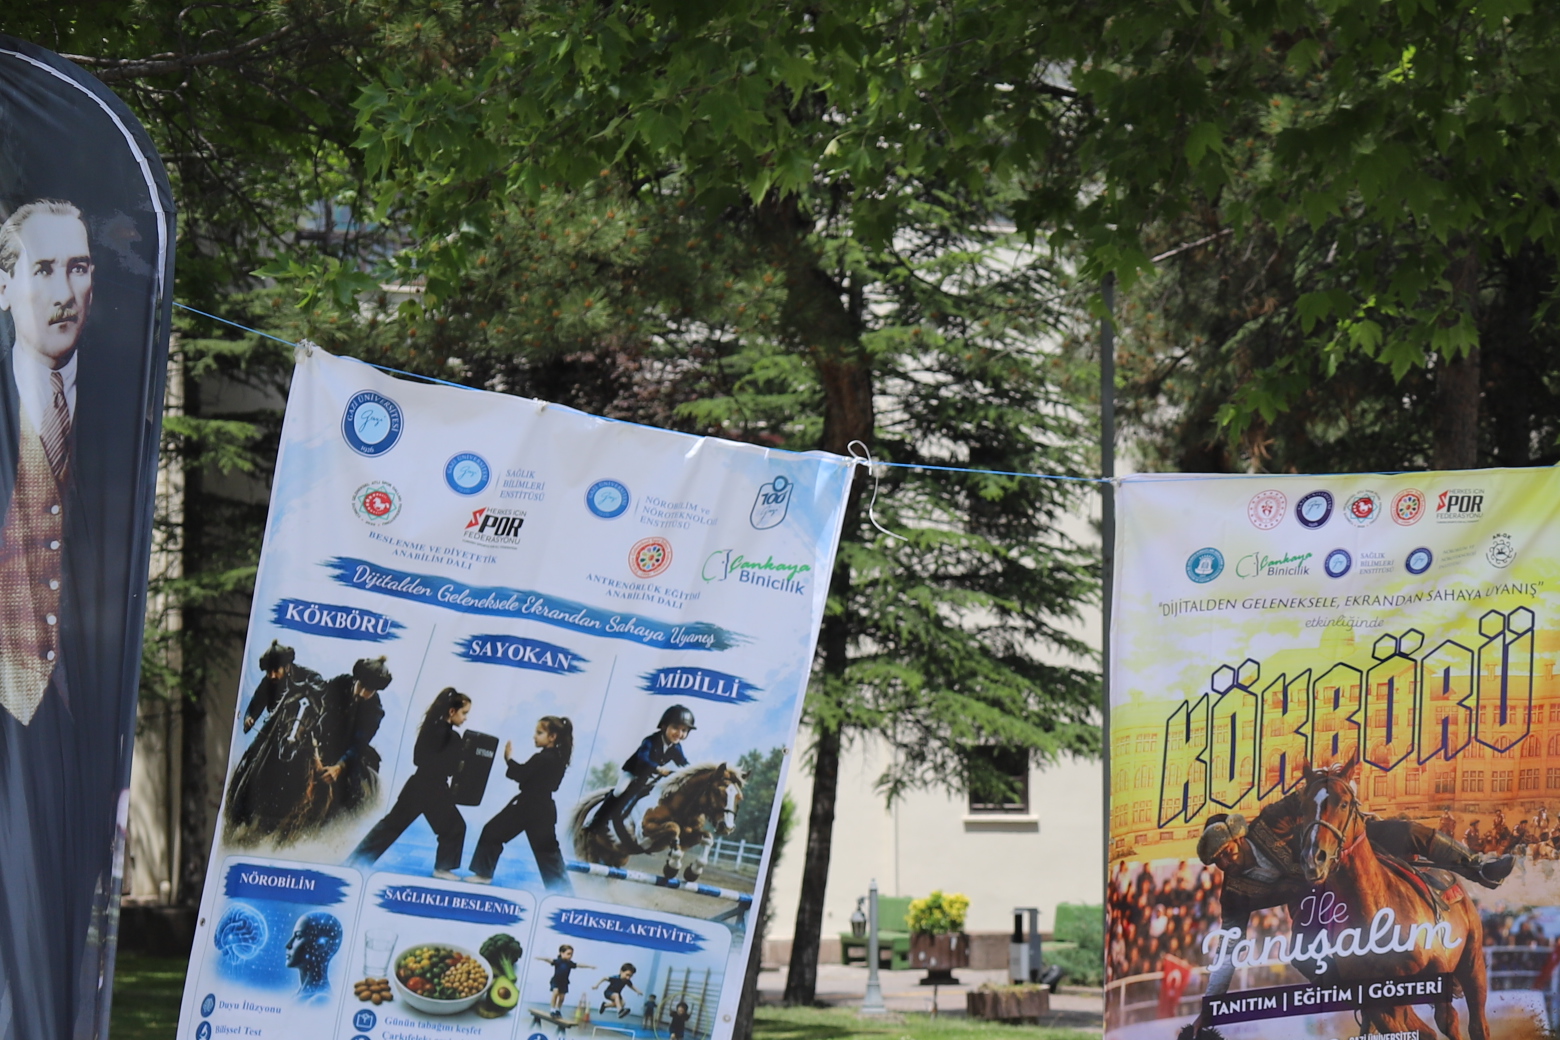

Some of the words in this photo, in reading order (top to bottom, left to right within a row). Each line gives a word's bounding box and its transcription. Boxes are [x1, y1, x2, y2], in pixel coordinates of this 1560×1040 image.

[506, 468, 536, 479] SAĞLIK
[500, 490, 544, 501] ENSTİTÜSÜ
[503, 480, 545, 490] BİLİMLERİ
[486, 507, 512, 515] HERKES
[1436, 490, 1484, 512] SPOR
[465, 507, 524, 537] SPOR
[368, 531, 426, 551] BESLENME
[430, 545, 441, 554] VE
[444, 547, 497, 565] DİYETETİK
[463, 531, 520, 544] FEDERASYONU
[392, 549, 443, 564] ANABİLİM
[446, 558, 472, 570] DALI
[1267, 566, 1310, 576] Binicilik
[586, 573, 661, 594] ANTRENÖRLÜK
[739, 570, 805, 596] Binicilik
[353, 565, 432, 596] Dijitalden
[437, 584, 519, 611] Geleneksele
[522, 596, 601, 629] Ekrandan
[605, 615, 665, 642] Sahaya
[606, 589, 655, 602] ANABİLİM
[658, 596, 683, 609] DALI
[1242, 597, 1340, 609] GELENEKSELE,
[1344, 593, 1424, 606] EKRANDAN
[1426, 589, 1481, 602] SAHAYA
[285, 603, 392, 636] KÖKBÖRÜ
[1305, 614, 1384, 632] etkinliğinde
[469, 640, 573, 670] SAYOKAN
[656, 670, 740, 698] MİDİLLİ
[1158, 605, 1535, 829] KÖKBÖRÜ
[239, 872, 316, 891] NÖROBİLİM
[385, 889, 450, 907] SAĞLIKLI
[1300, 889, 1349, 926] İle
[561, 912, 624, 933] FİZİKSEL
[626, 924, 695, 944] AKTİVİTE
[1202, 907, 1462, 974] Tanışalım
[219, 1001, 239, 1010] Duyu
[243, 1000, 281, 1014] İlüzyonu
[1210, 996, 1277, 1016] TANITIM
[1294, 987, 1352, 1007] EĞİTİM
[1368, 977, 1442, 999] GÖSTERİ
[244, 1027, 262, 1036] Test
[385, 1017, 415, 1027] Günün
[418, 1021, 453, 1032] tabağını
[456, 1025, 481, 1035] keşfet
